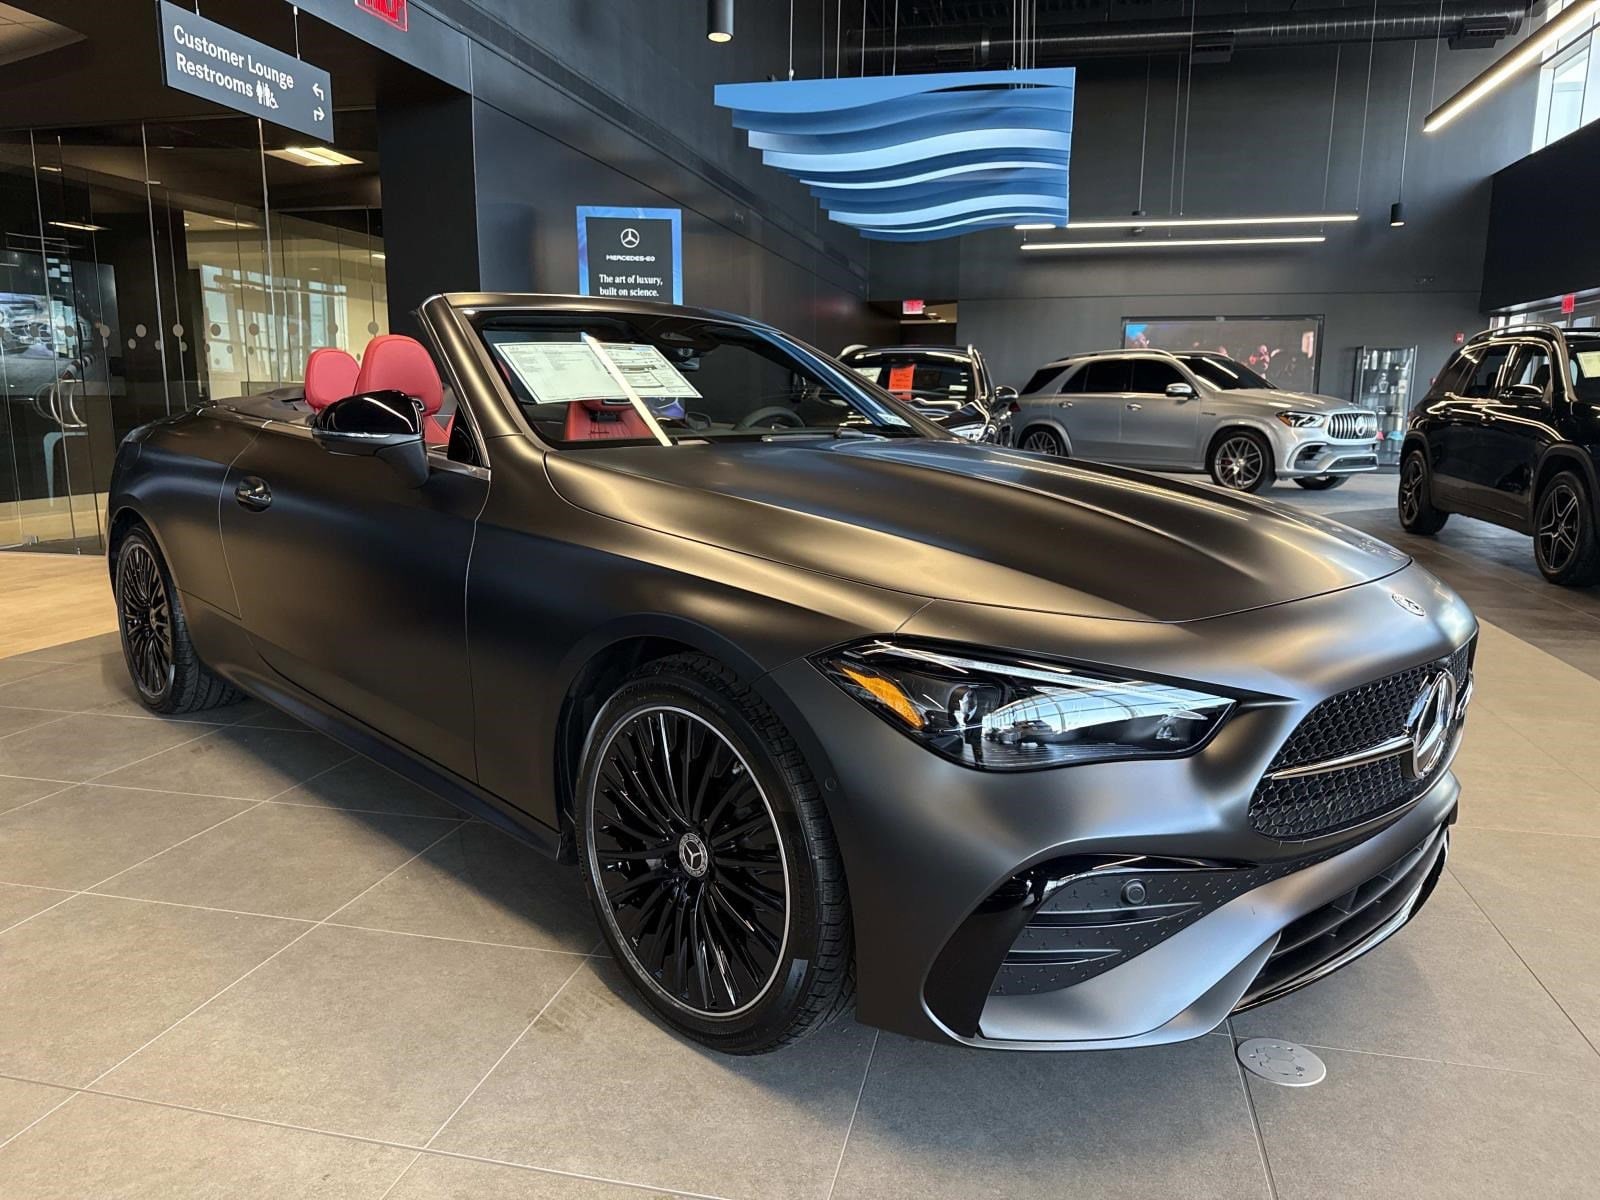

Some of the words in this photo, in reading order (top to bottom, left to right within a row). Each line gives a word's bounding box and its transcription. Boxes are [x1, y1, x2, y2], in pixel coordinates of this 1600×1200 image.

[173, 24, 245, 68] Customer
[248, 54, 294, 90] Lounge
[176, 52, 254, 97] Restrooms
[599, 274, 613, 284] The
[614, 275, 626, 284] art
[627, 274, 636, 284] of
[636, 275, 663, 286] luxury,
[599, 286, 617, 296] built
[618, 288, 628, 296] on
[629, 287, 660, 297] science.
